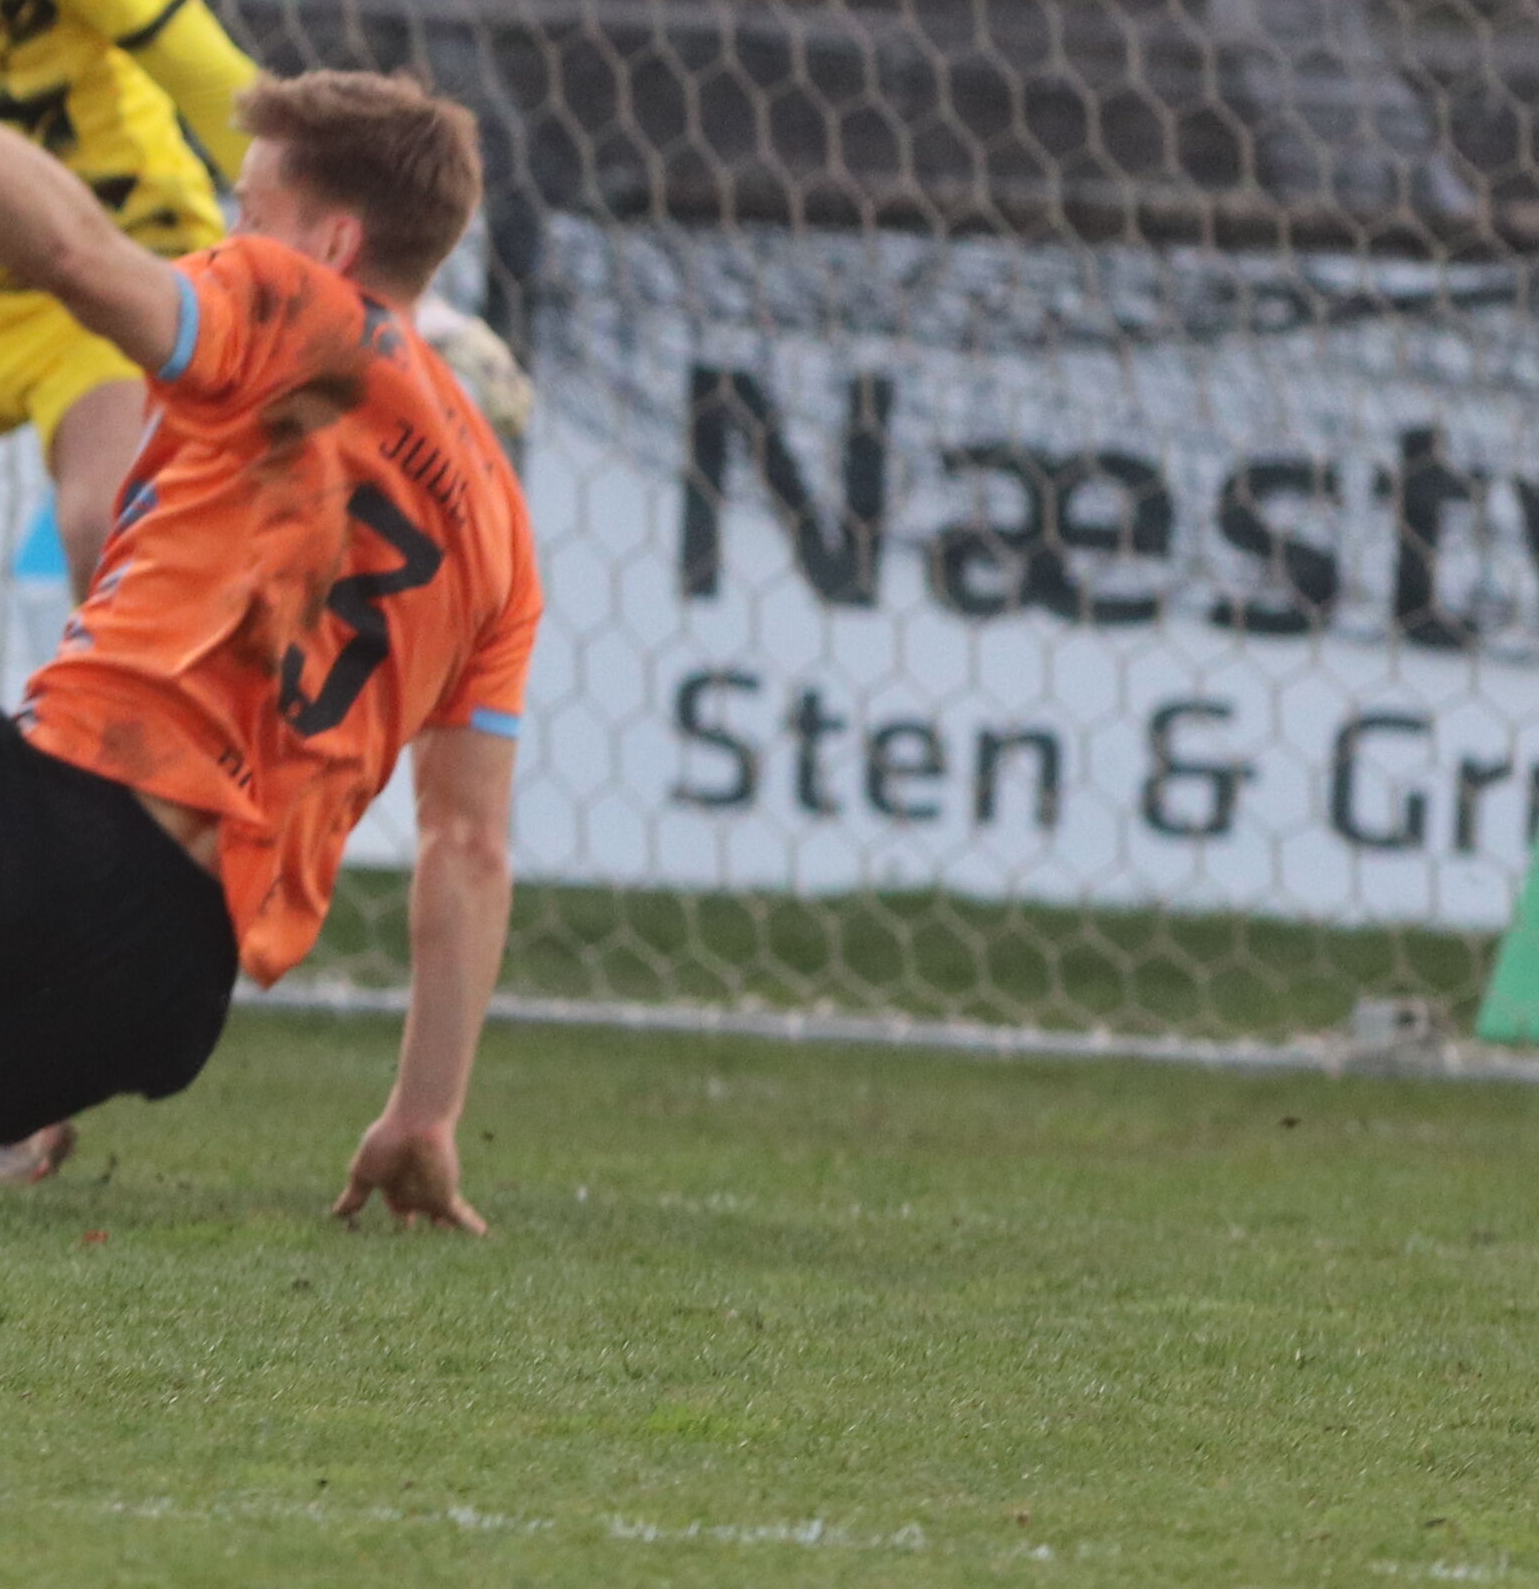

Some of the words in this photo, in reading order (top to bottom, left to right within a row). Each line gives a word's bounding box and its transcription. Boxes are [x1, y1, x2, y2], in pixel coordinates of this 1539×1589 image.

[278, 481, 445, 737] 3
[678, 361, 1539, 651] Næst
[668, 664, 1064, 829] Sten
[1136, 699, 1256, 841] &
[1328, 711, 1539, 857] Gr
